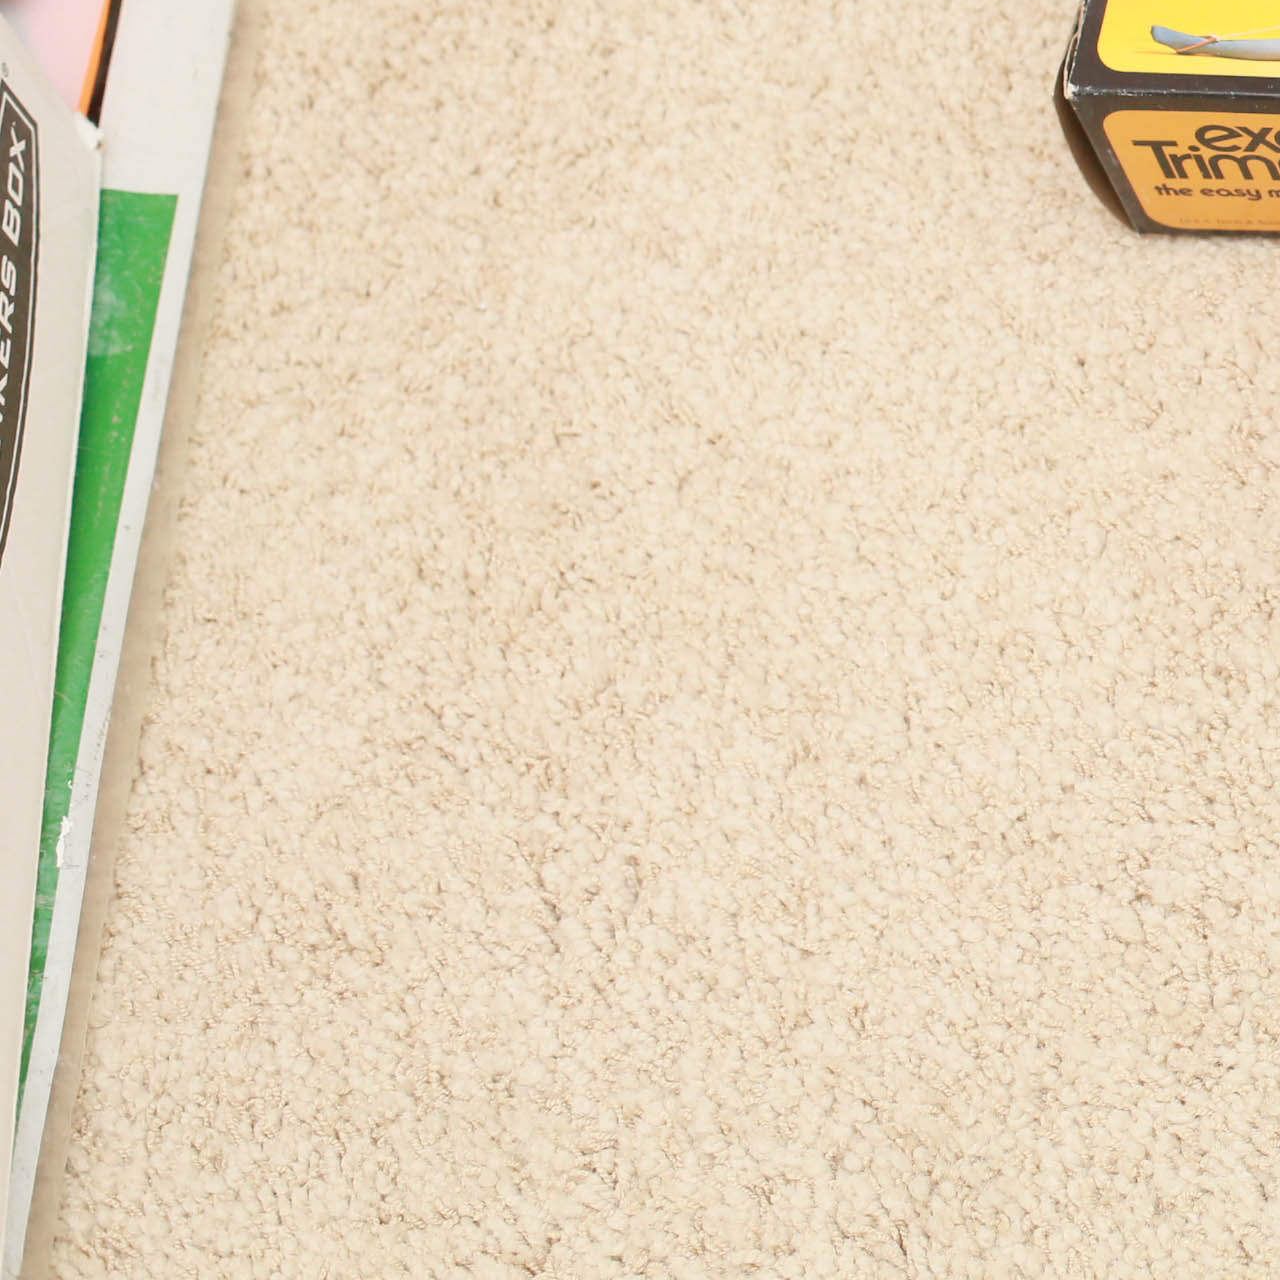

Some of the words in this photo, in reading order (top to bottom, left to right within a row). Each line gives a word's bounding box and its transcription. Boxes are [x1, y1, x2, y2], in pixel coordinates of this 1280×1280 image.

[2, 126, 26, 247] BOX
[1154, 184, 1193, 196] the
[1199, 187, 1262, 201] easy
